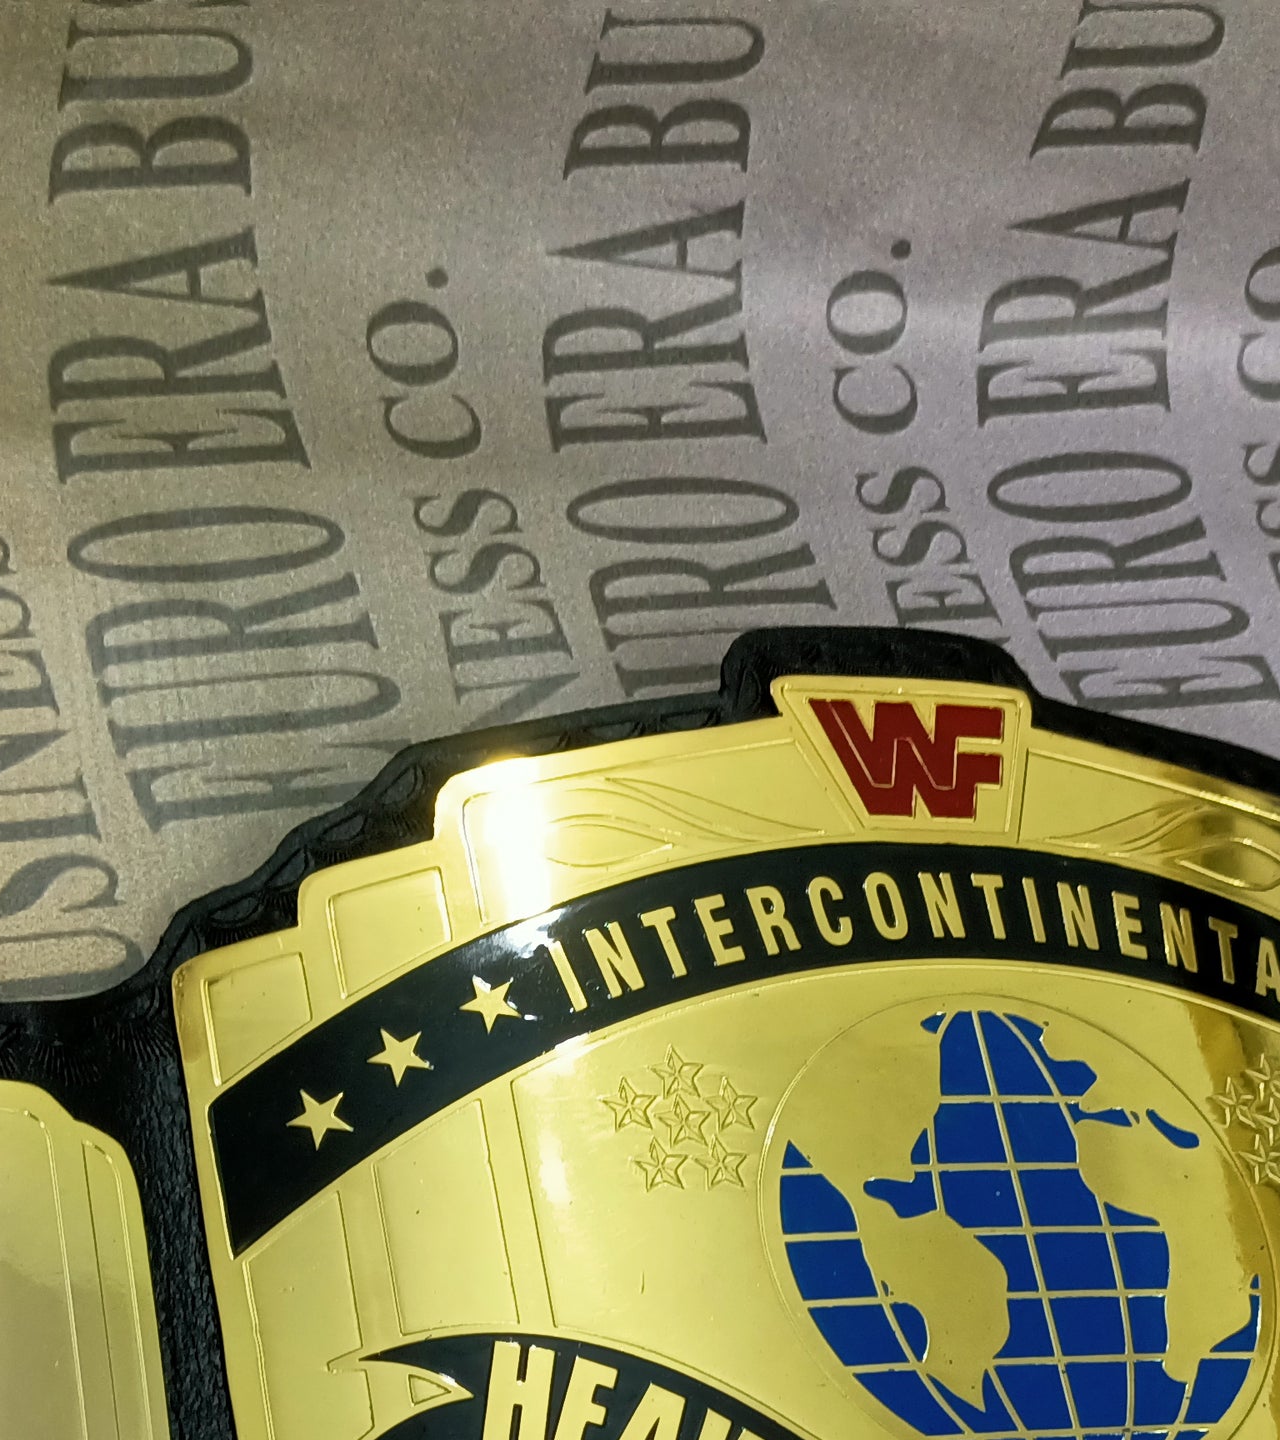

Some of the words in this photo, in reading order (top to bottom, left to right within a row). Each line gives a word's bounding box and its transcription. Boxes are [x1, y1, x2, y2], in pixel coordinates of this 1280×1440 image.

[45, 226, 312, 483] ERA
[365, 267, 483, 459] CO.
[541, 199, 768, 452] ERA
[825, 238, 919, 436] CO.
[976, 178, 1191, 427] ERA
[67, 505, 413, 834] EURO
